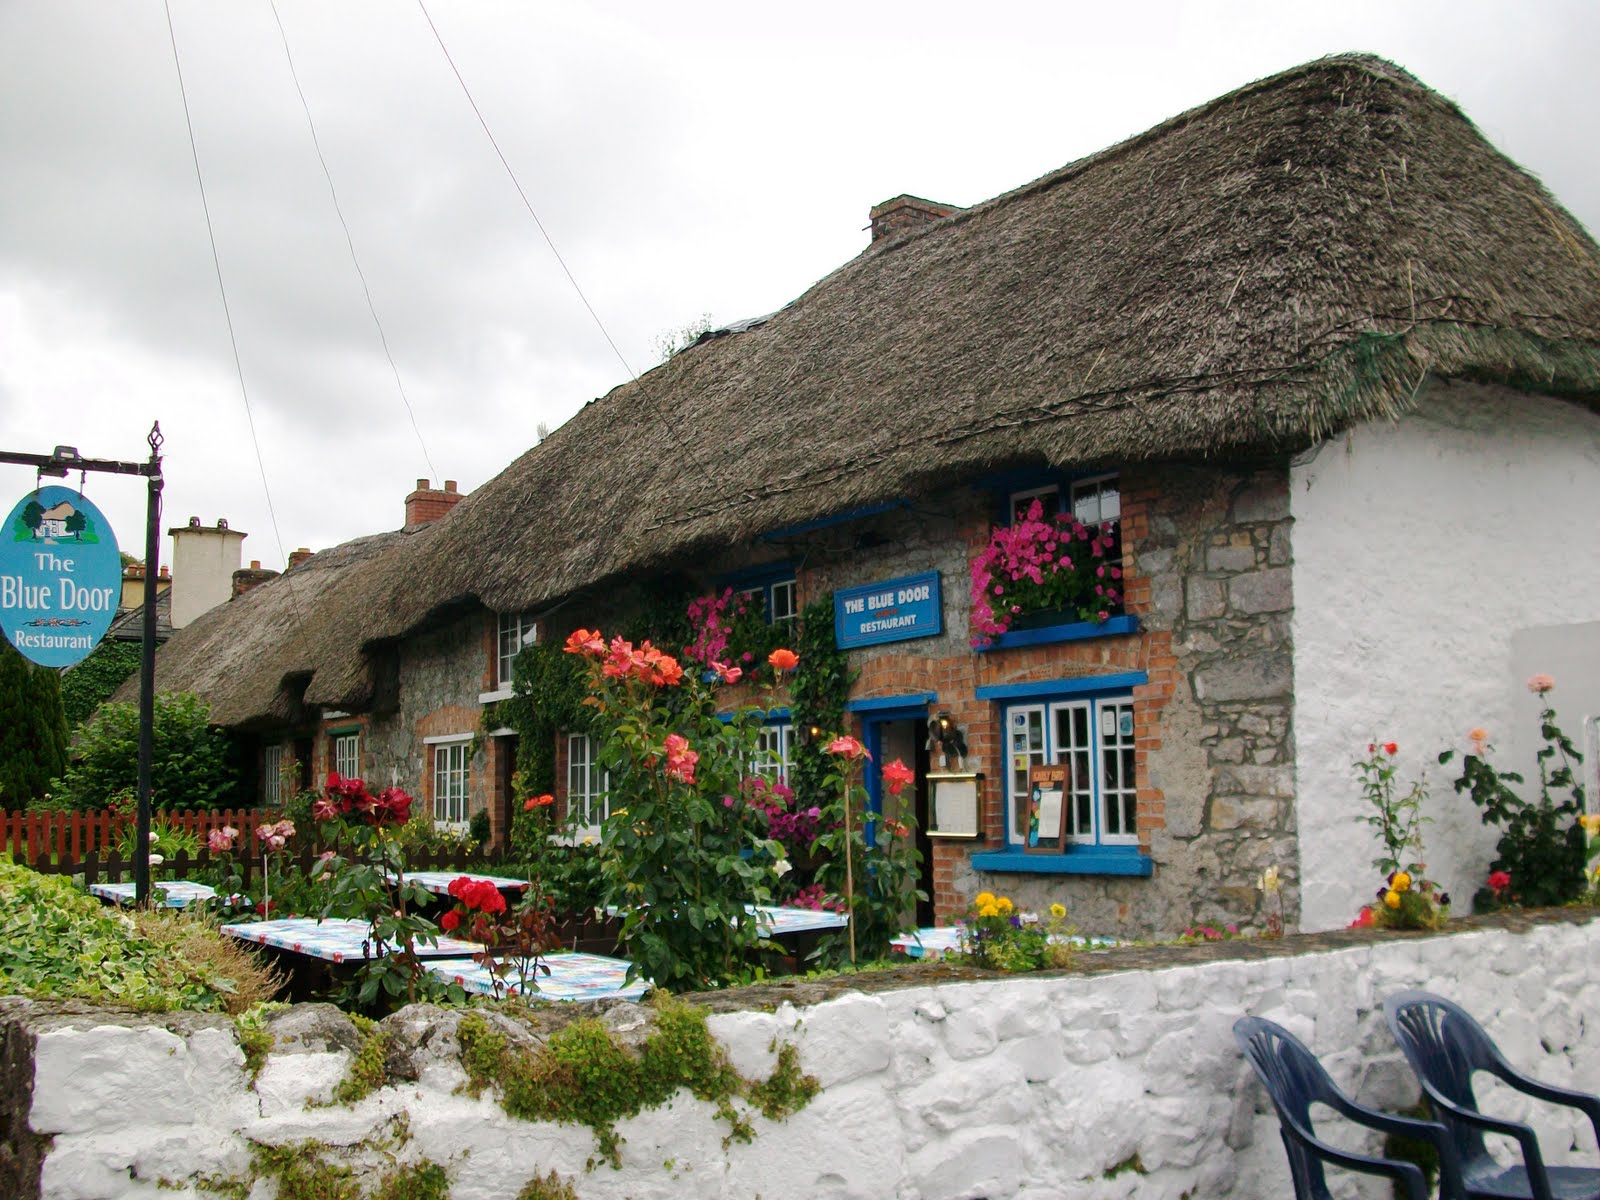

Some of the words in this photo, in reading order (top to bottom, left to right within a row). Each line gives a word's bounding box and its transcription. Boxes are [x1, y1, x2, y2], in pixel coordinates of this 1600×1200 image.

[34, 553, 75, 571] The
[1, 576, 51, 609] Blue
[60, 578, 113, 611] Door
[845, 599, 864, 614] THE
[868, 593, 894, 610] BLUE
[898, 586, 929, 604] DOOR
[860, 615, 916, 633] RESTAURANT
[15, 630, 93, 649] Restaurant
